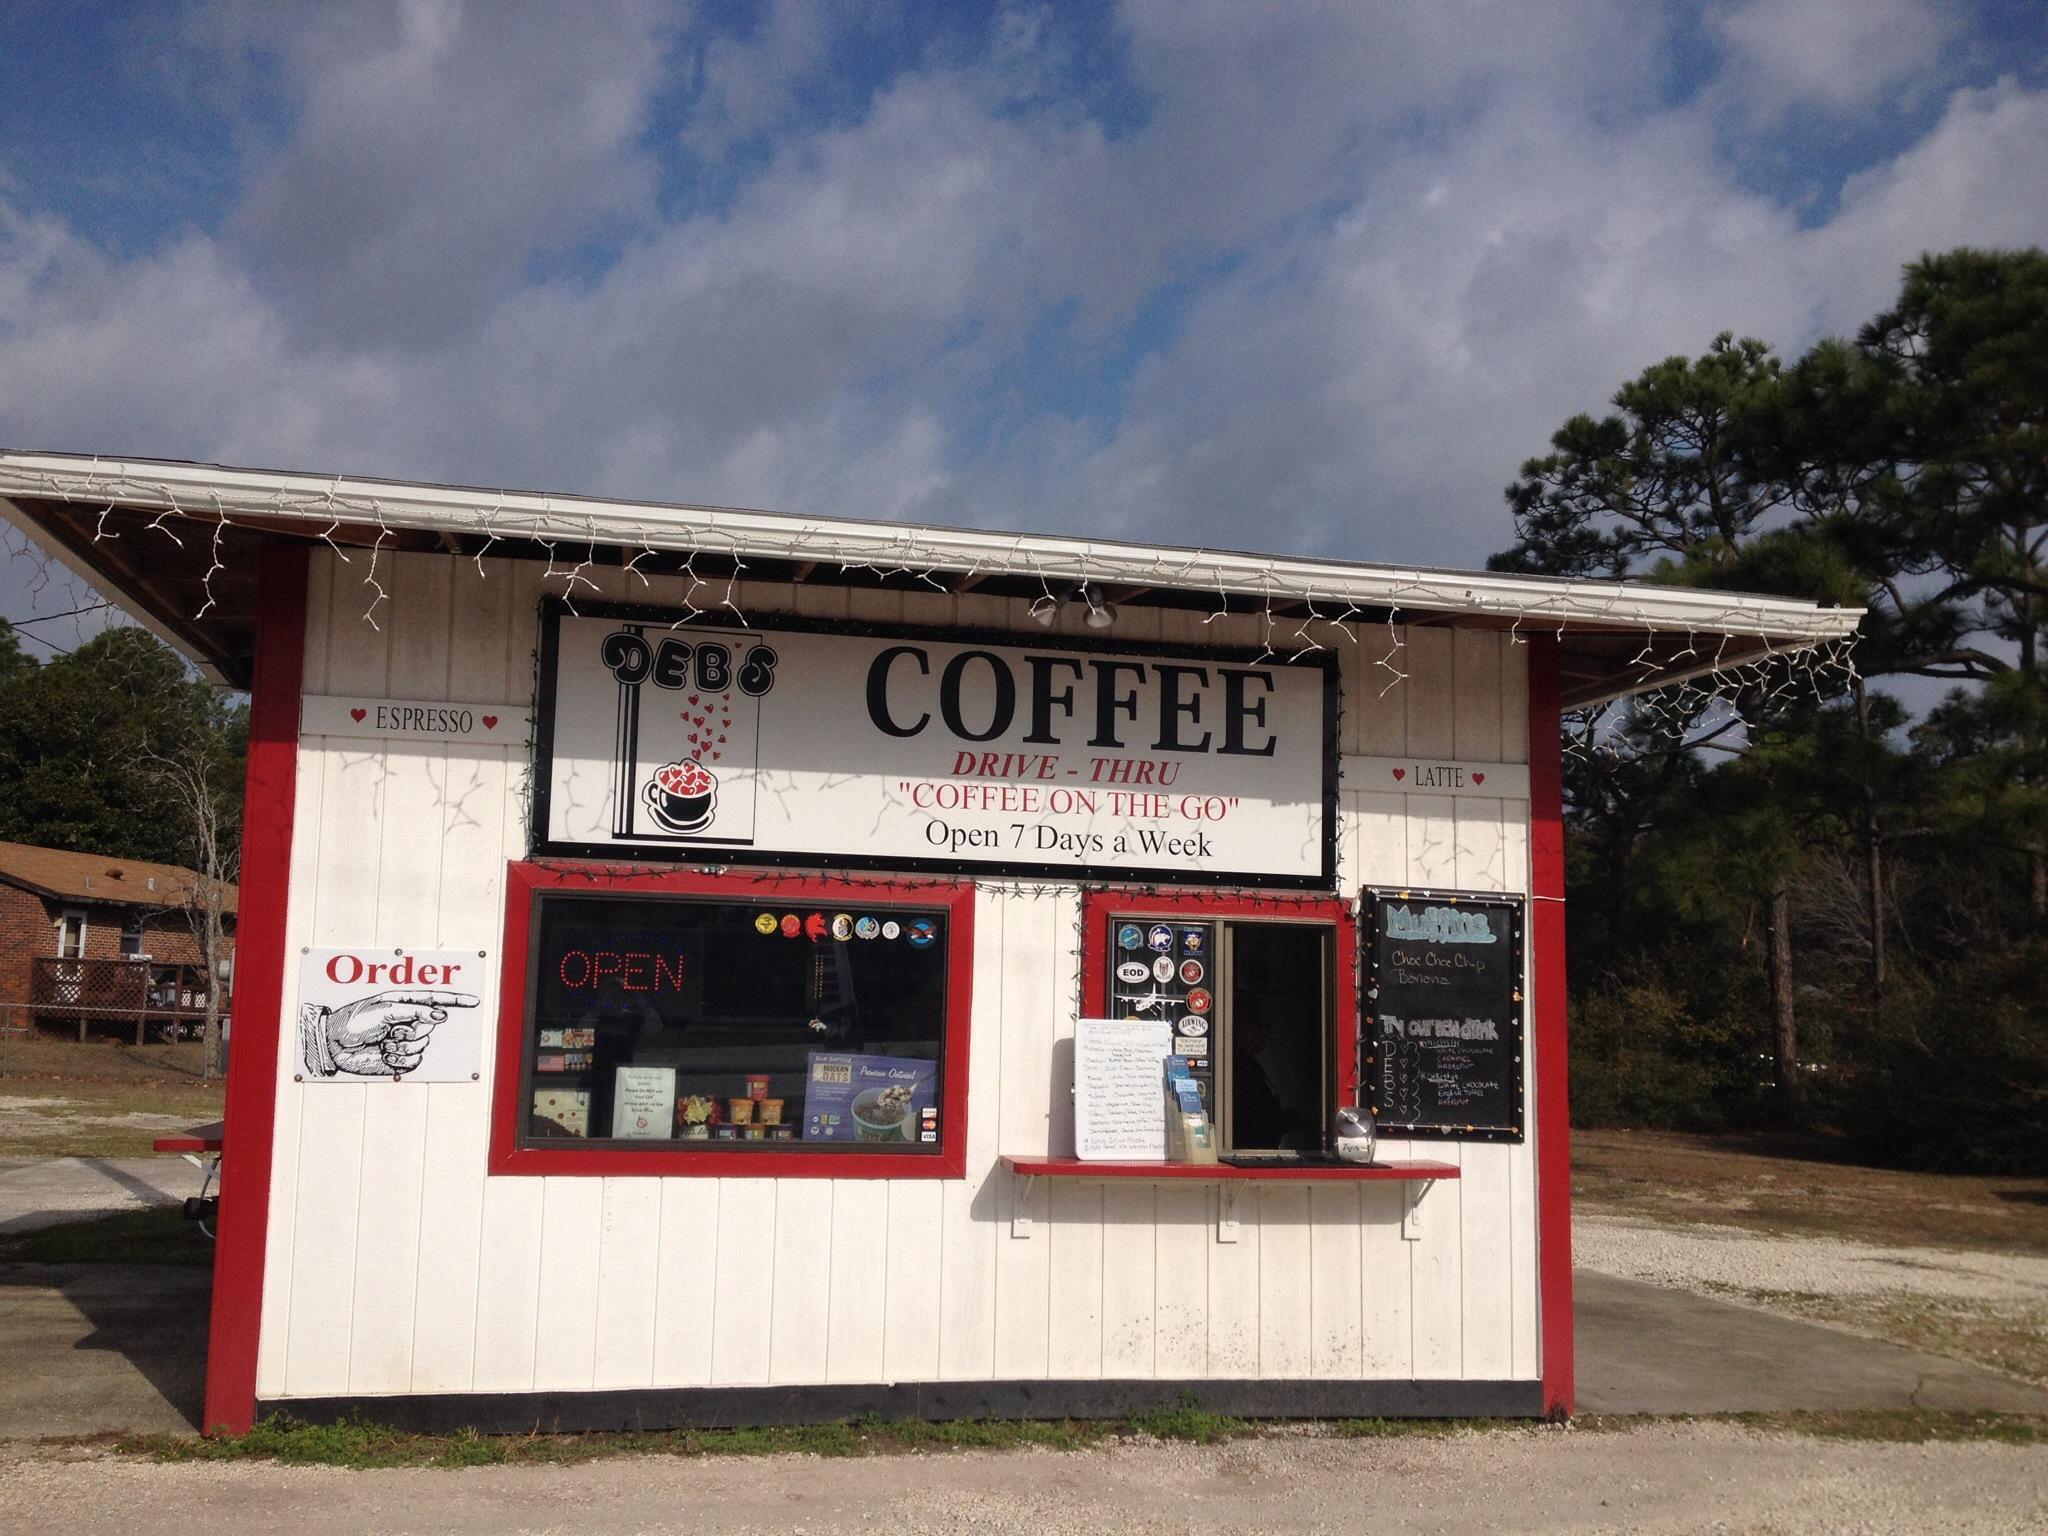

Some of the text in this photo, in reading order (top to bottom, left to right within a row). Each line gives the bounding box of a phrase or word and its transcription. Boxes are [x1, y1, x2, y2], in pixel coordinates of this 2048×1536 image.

[866, 646, 1277, 757] COFFEE
[376, 706, 473, 734] ESPRESSO
[952, 751, 1059, 780] DRIVE
[1089, 757, 1183, 786] THRU
[1415, 765, 1464, 788] LATTE
[899, 782, 1239, 821] "COFFEE ON THE GO"
[925, 820, 1213, 858] Open 7 Days a Week
[326, 954, 462, 985] Order
[1392, 950, 1421, 966] Choc
[559, 949, 686, 993] OPEN
[1122, 968, 1144, 977] EOD
[1393, 968, 1451, 985] Banana
[823, 1064, 849, 1072] MODERN
[823, 1072, 849, 1082] OATS
[888, 1068, 917, 1080] Oatmeal
